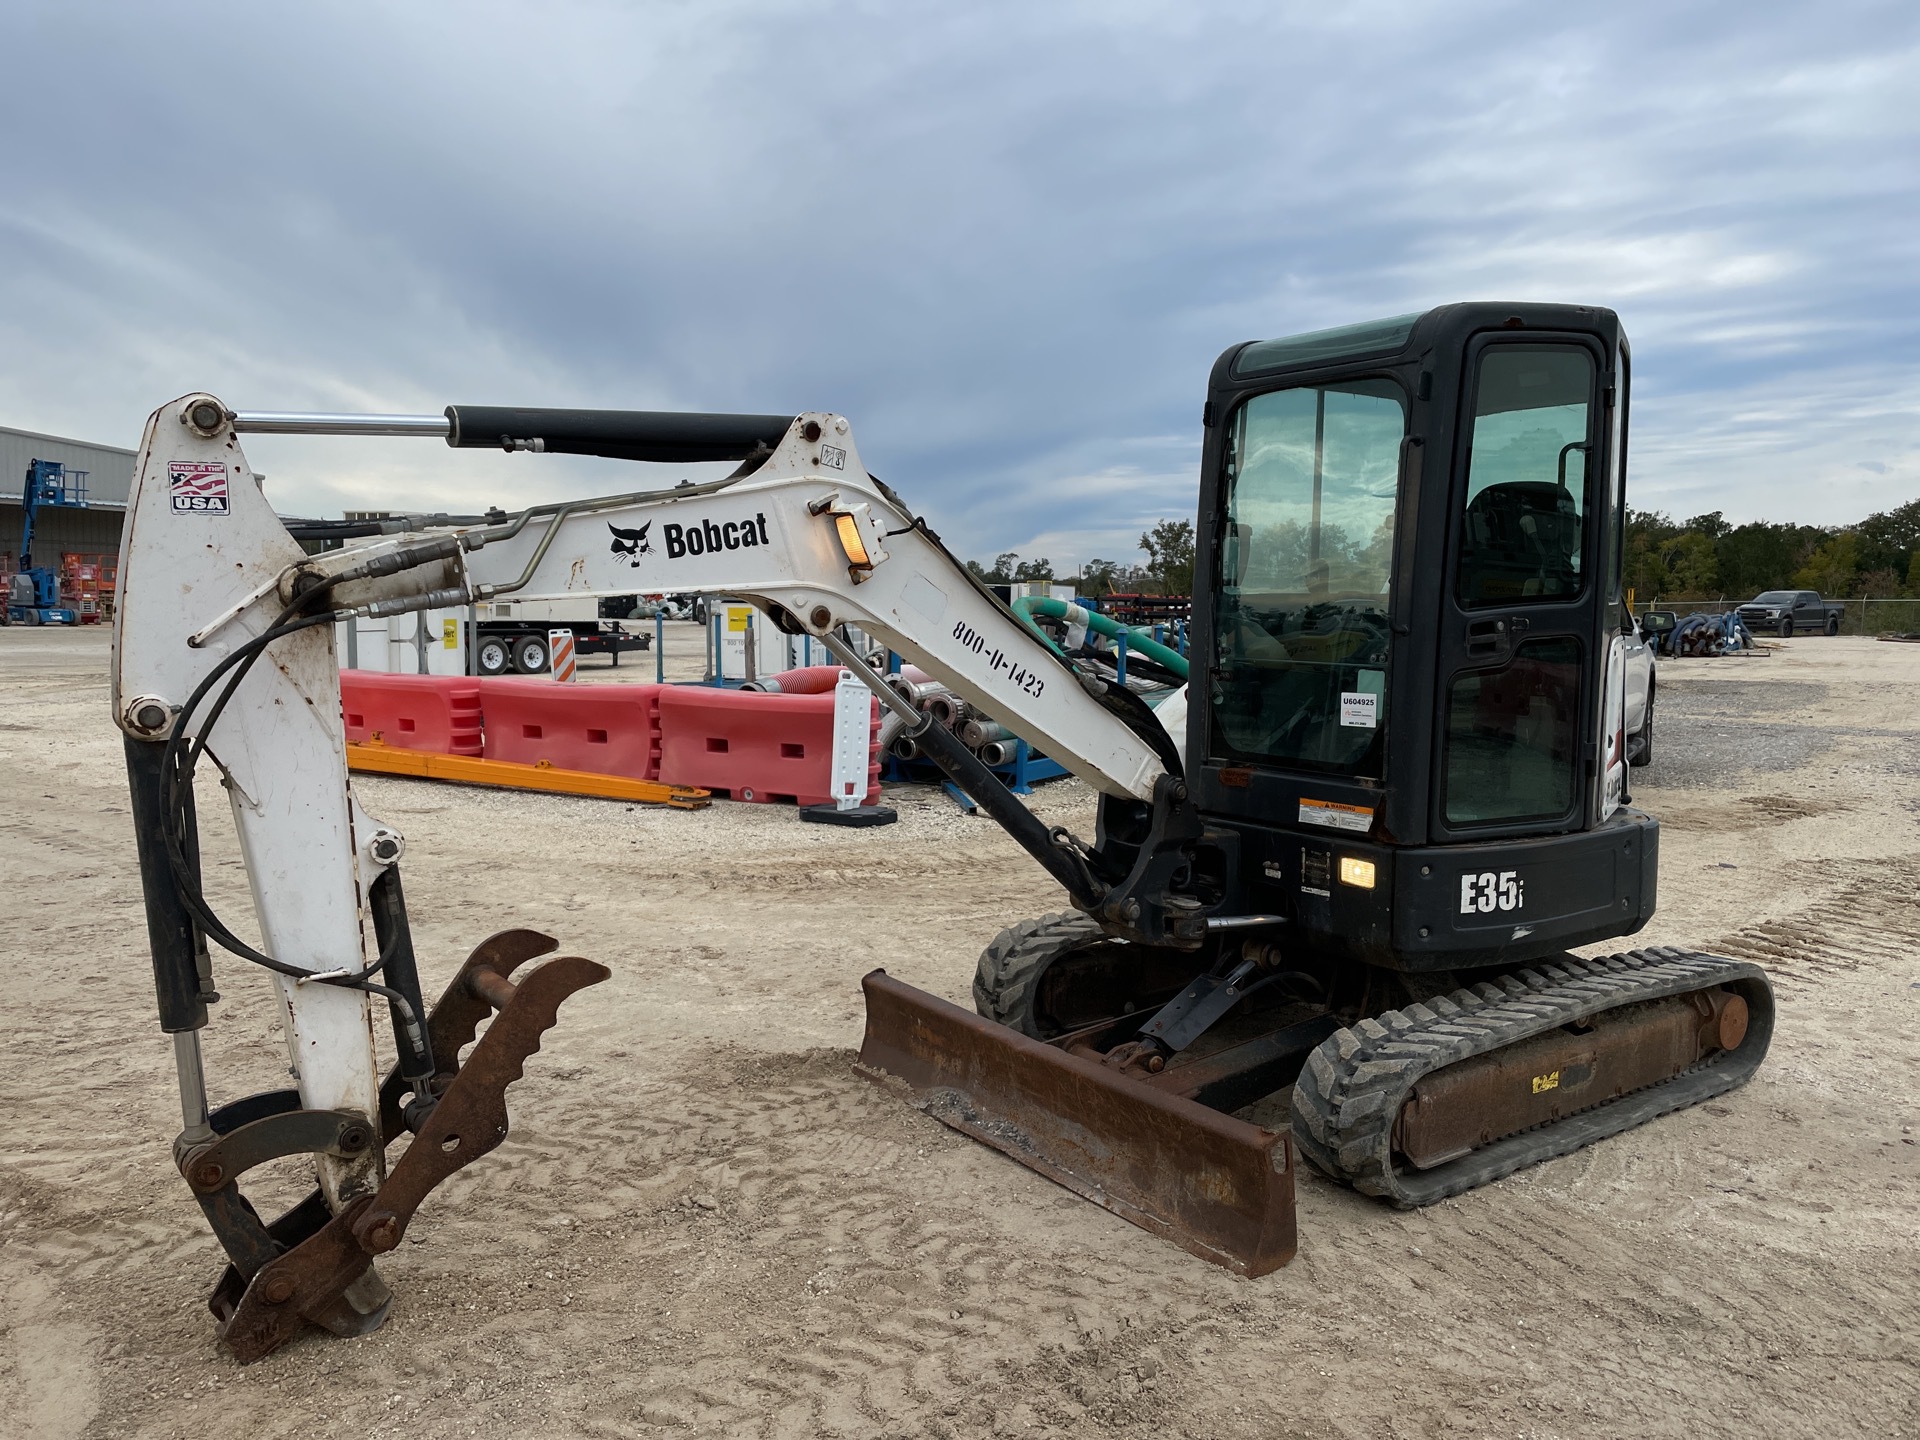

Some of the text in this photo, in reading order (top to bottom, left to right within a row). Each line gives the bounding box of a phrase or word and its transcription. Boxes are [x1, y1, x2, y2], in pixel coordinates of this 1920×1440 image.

[175, 497, 225, 510] USA
[663, 512, 769, 559] Bobcat
[953, 621, 1045, 698] 800-11-1423
[1343, 698, 1375, 706] U604925
[1330, 803, 1356, 812] WARNING
[1460, 870, 1524, 914] E35i
